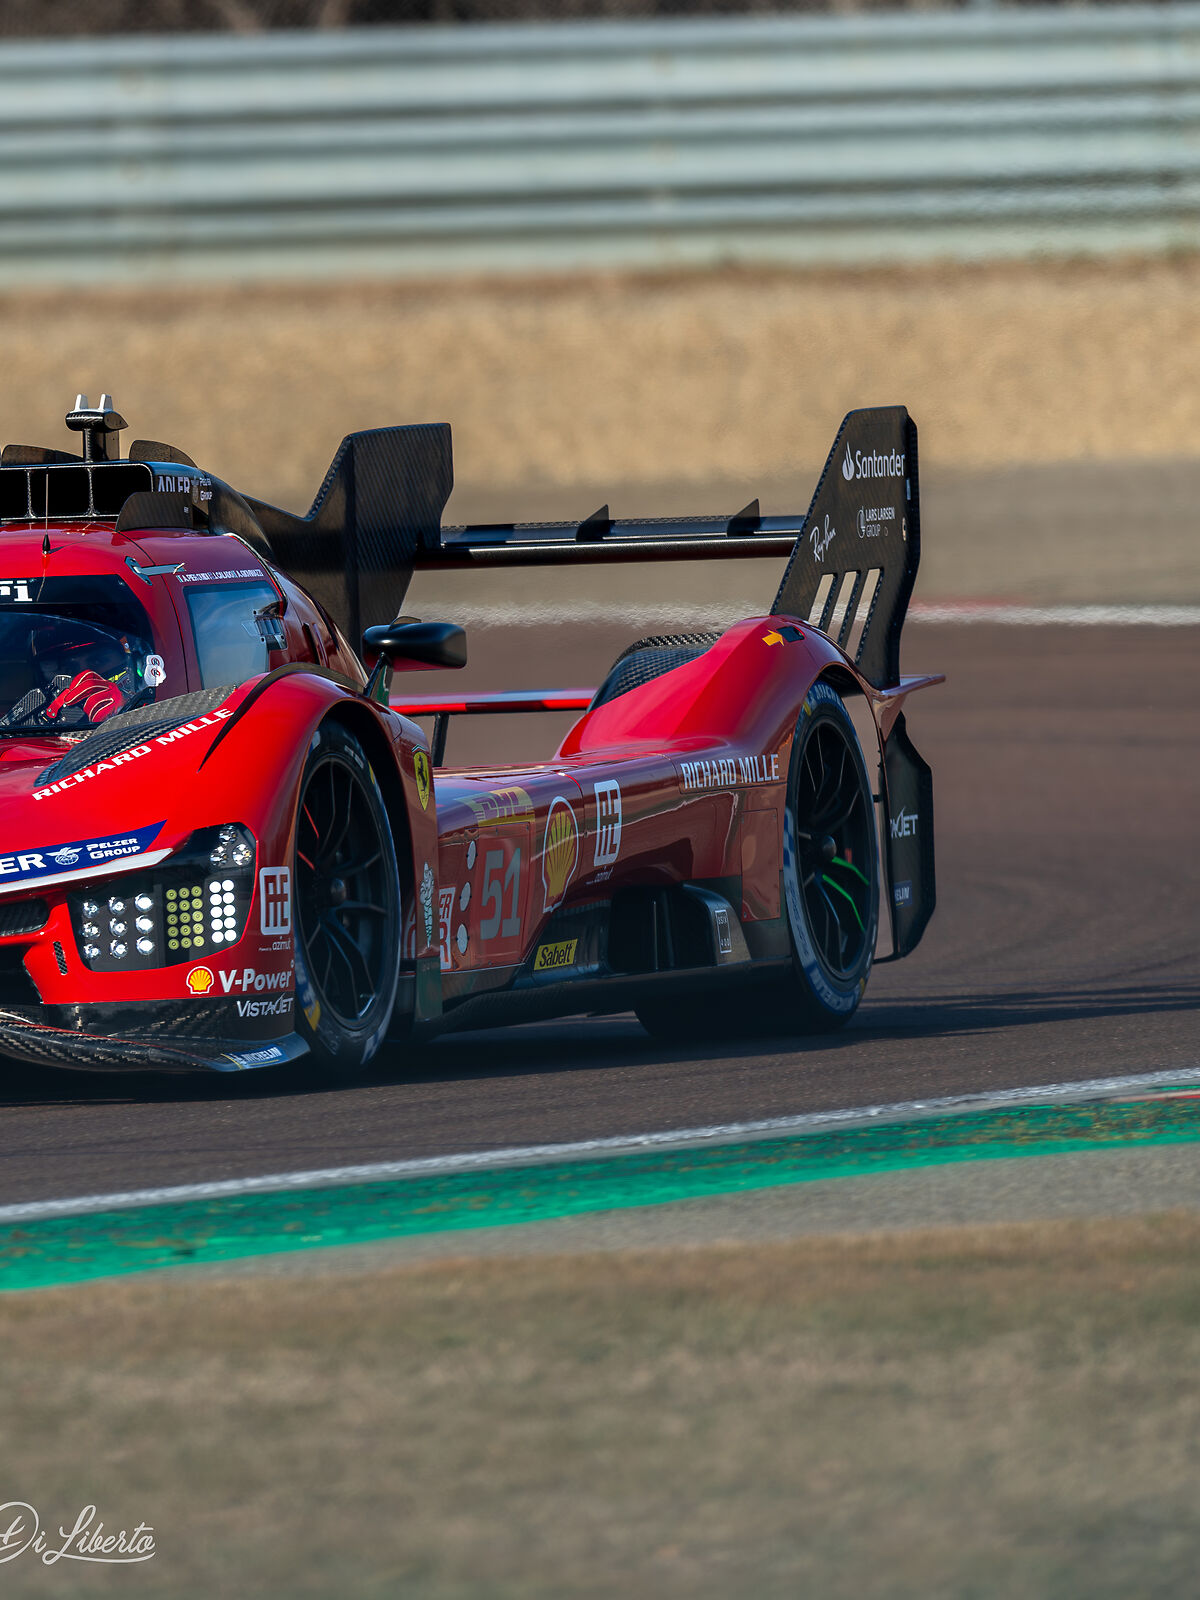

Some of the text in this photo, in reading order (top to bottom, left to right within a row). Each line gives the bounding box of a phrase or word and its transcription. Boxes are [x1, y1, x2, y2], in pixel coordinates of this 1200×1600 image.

[855, 448, 905, 480] Santander
[865, 506, 896, 522] LARS LARSEN
[866, 523, 881, 538] GROUP
[32, 708, 235, 801] RICHARD MILLE
[680, 753, 780, 789] RICHARD MILLE
[86, 838, 138, 851] PELZER
[89, 845, 141, 860] GROUP
[479, 847, 522, 941] 51
[539, 942, 573, 968] Sabelt
[219, 968, 292, 993] V-Power
